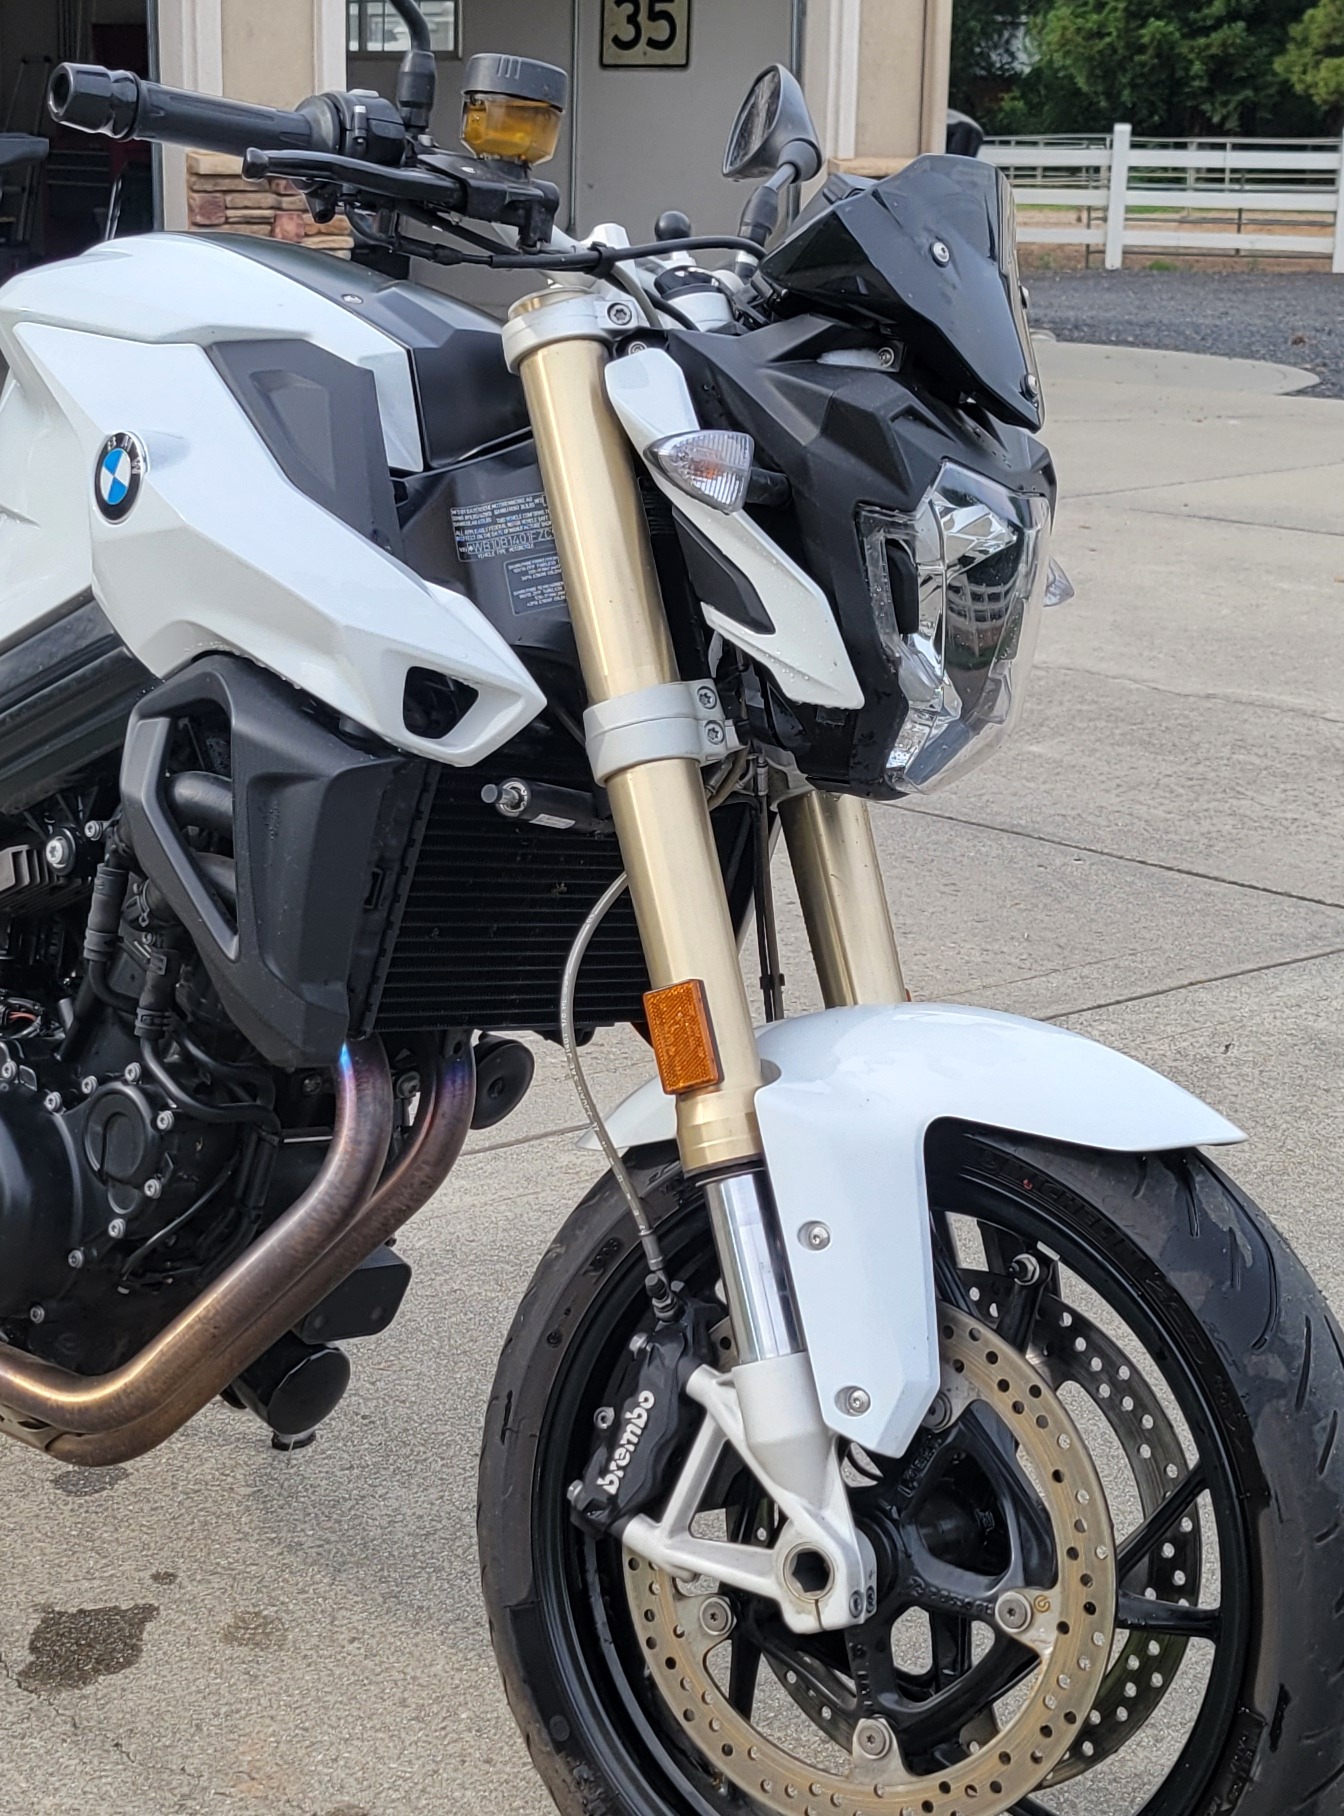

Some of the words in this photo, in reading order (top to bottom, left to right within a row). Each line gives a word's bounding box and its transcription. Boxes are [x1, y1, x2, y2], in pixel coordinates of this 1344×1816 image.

[611, 0, 677, 51] 35
[474, 528, 554, 553] WB10B1401FZC
[596, 1390, 655, 1495] brembo
